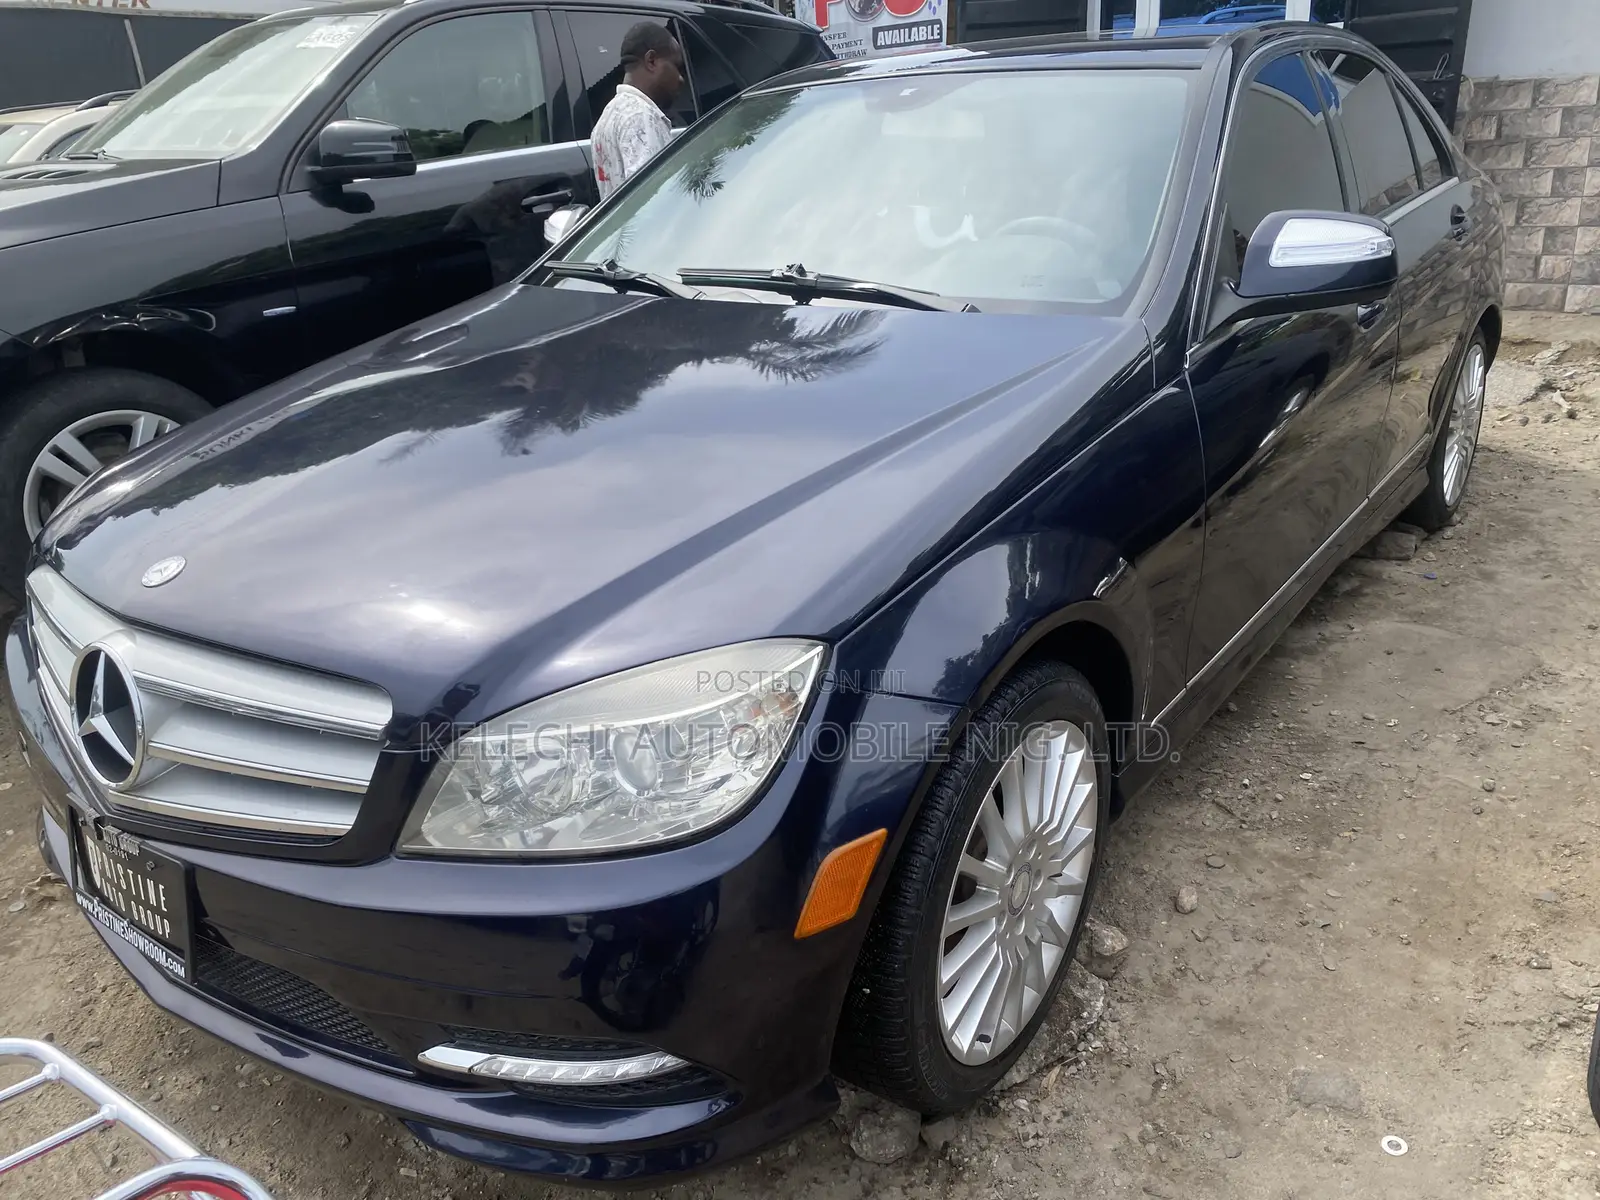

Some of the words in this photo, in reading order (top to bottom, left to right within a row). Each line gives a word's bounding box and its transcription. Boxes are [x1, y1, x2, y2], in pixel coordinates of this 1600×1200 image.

[831, 39, 863, 50] PAYMENT
[876, 24, 940, 46] AVAILABLE
[96, 845, 167, 912] PRISTINE
[101, 877, 126, 912] AUTO
[130, 900, 171, 939] GROUP
